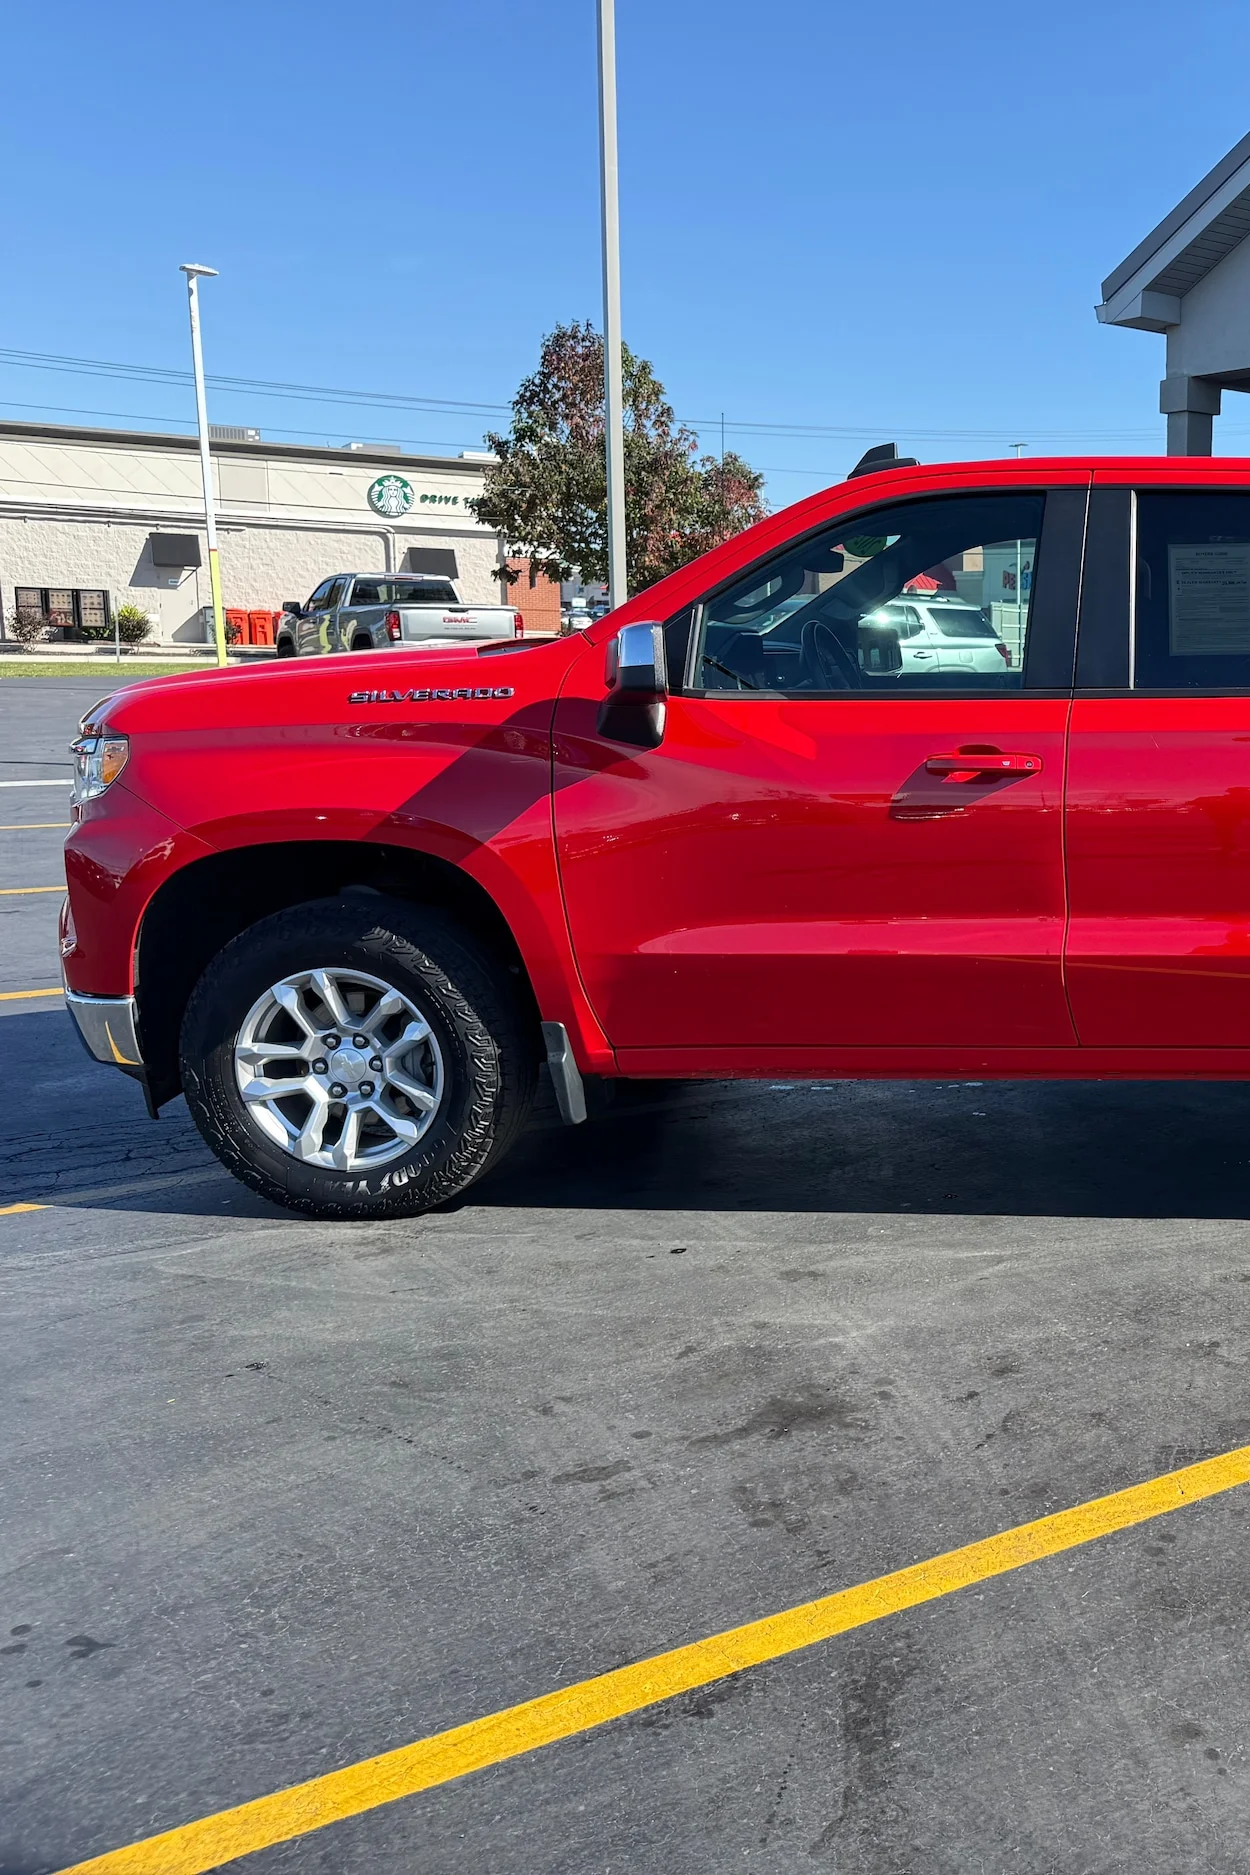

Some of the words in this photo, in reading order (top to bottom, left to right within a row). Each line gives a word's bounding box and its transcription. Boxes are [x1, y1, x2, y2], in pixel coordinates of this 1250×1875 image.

[420, 493, 459, 506] DRIVE
[442, 616, 478, 624] GMC
[348, 686, 517, 704] SILVERADO
